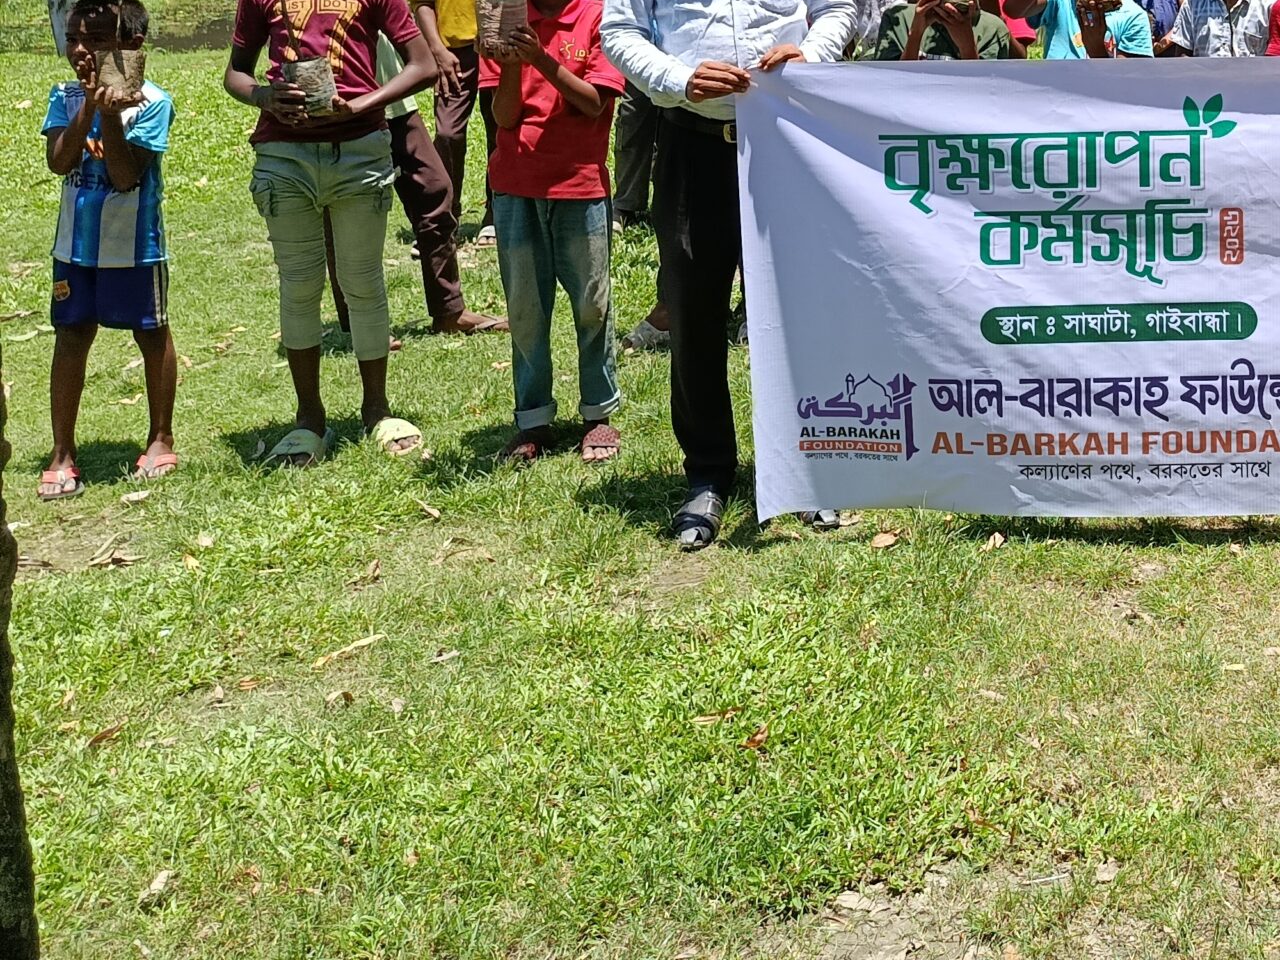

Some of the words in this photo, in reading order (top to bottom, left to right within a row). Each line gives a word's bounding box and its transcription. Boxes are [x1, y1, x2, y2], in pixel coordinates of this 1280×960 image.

[323, 0, 341, 8] DO
[879, 130, 1208, 215] বৃক্ষরোপন
[974, 195, 1209, 285] কর্মসূচি
[996, 313, 1039, 341] স্থান
[1062, 307, 1137, 339] সাঘাটা,
[1145, 306, 1231, 336] গাইবান্ধা
[928, 375, 1170, 422] আল-বারাকাহ
[800, 426, 901, 440] AL-BARAKAH
[931, 431, 1129, 456] AL-BARKAH
[803, 441, 898, 452] FOUNDATION
[1018, 462, 1092, 481] কল্যাণের
[1100, 462, 1141, 482] পথে,
[1150, 462, 1223, 480] বরকতের
[1231, 460, 1272, 479] সাথে
